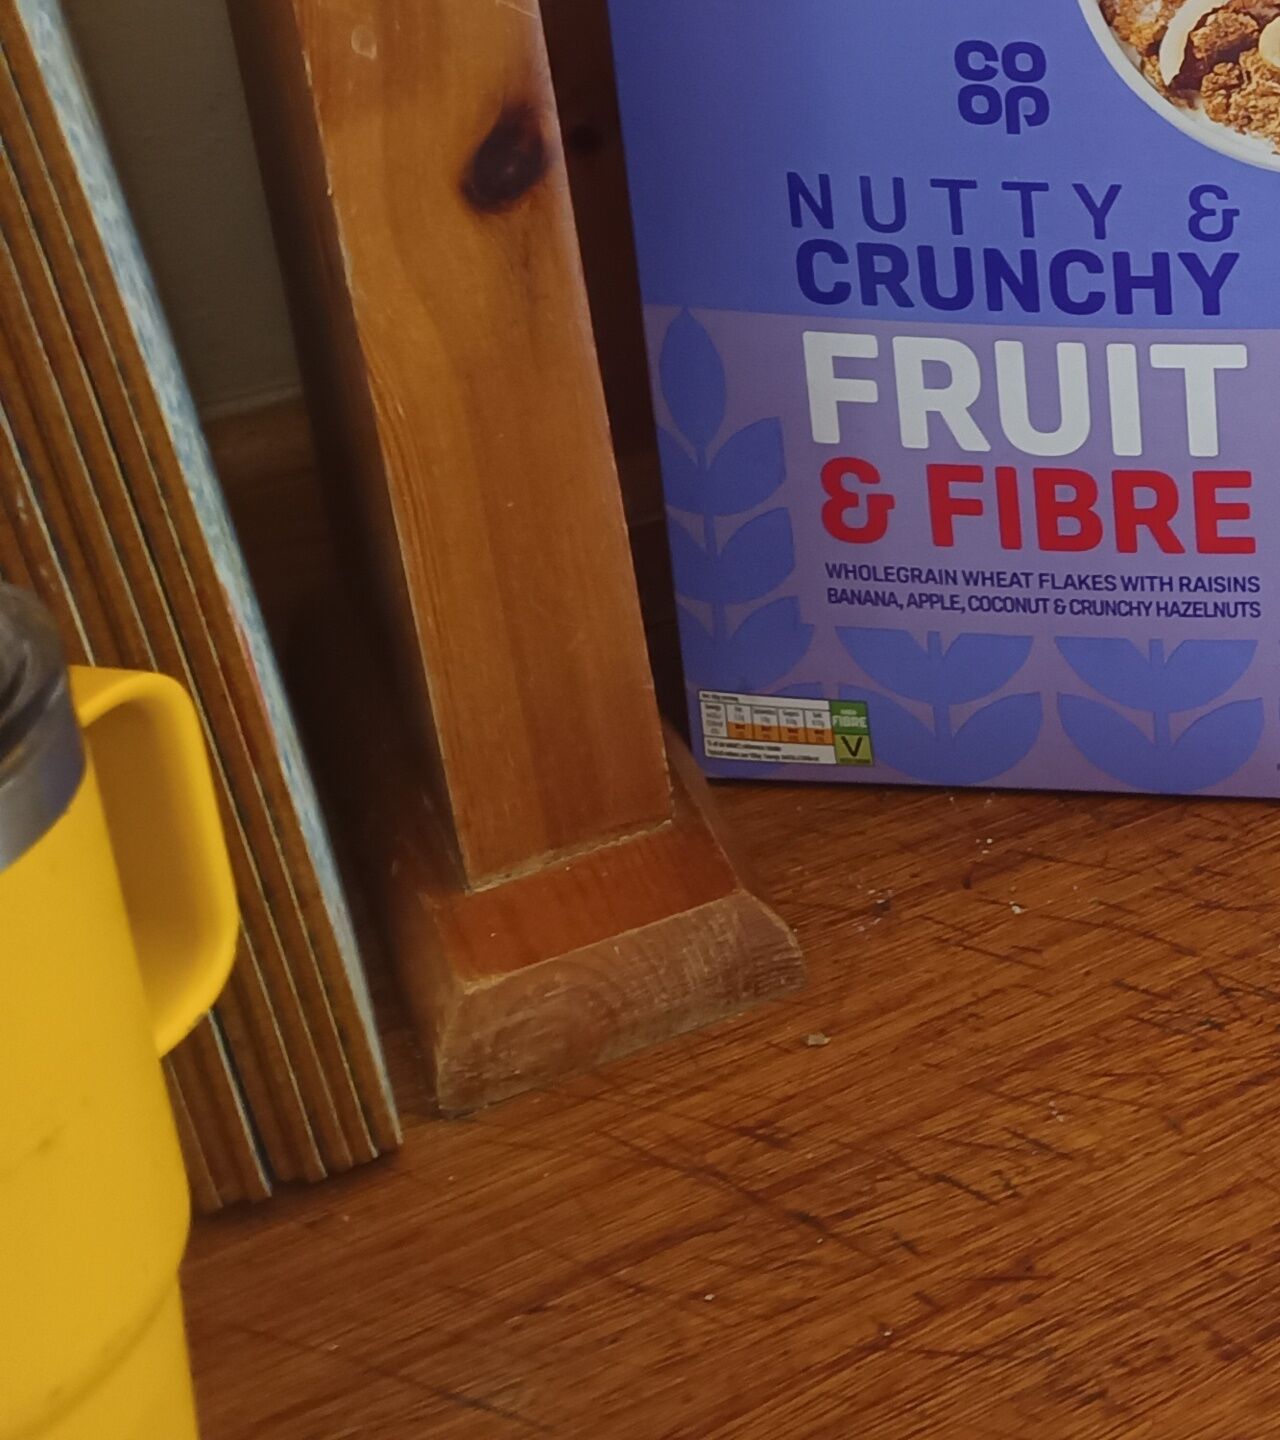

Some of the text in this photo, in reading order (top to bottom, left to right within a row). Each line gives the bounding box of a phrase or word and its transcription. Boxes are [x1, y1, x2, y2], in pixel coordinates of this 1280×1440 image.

[786, 171, 1240, 242] NUTTY &
[795, 238, 1241, 316] CRUNCHY
[802, 330, 1248, 458] FRUIT
[820, 456, 1257, 555] & FIBRE
[825, 563, 1261, 594] WHOLEGRAIN WHEAT FLAKES WITH RAISINS
[827, 587, 1261, 619] BANANA, APPLE, COCONUT & CRUNCHY HAZELNUTS
